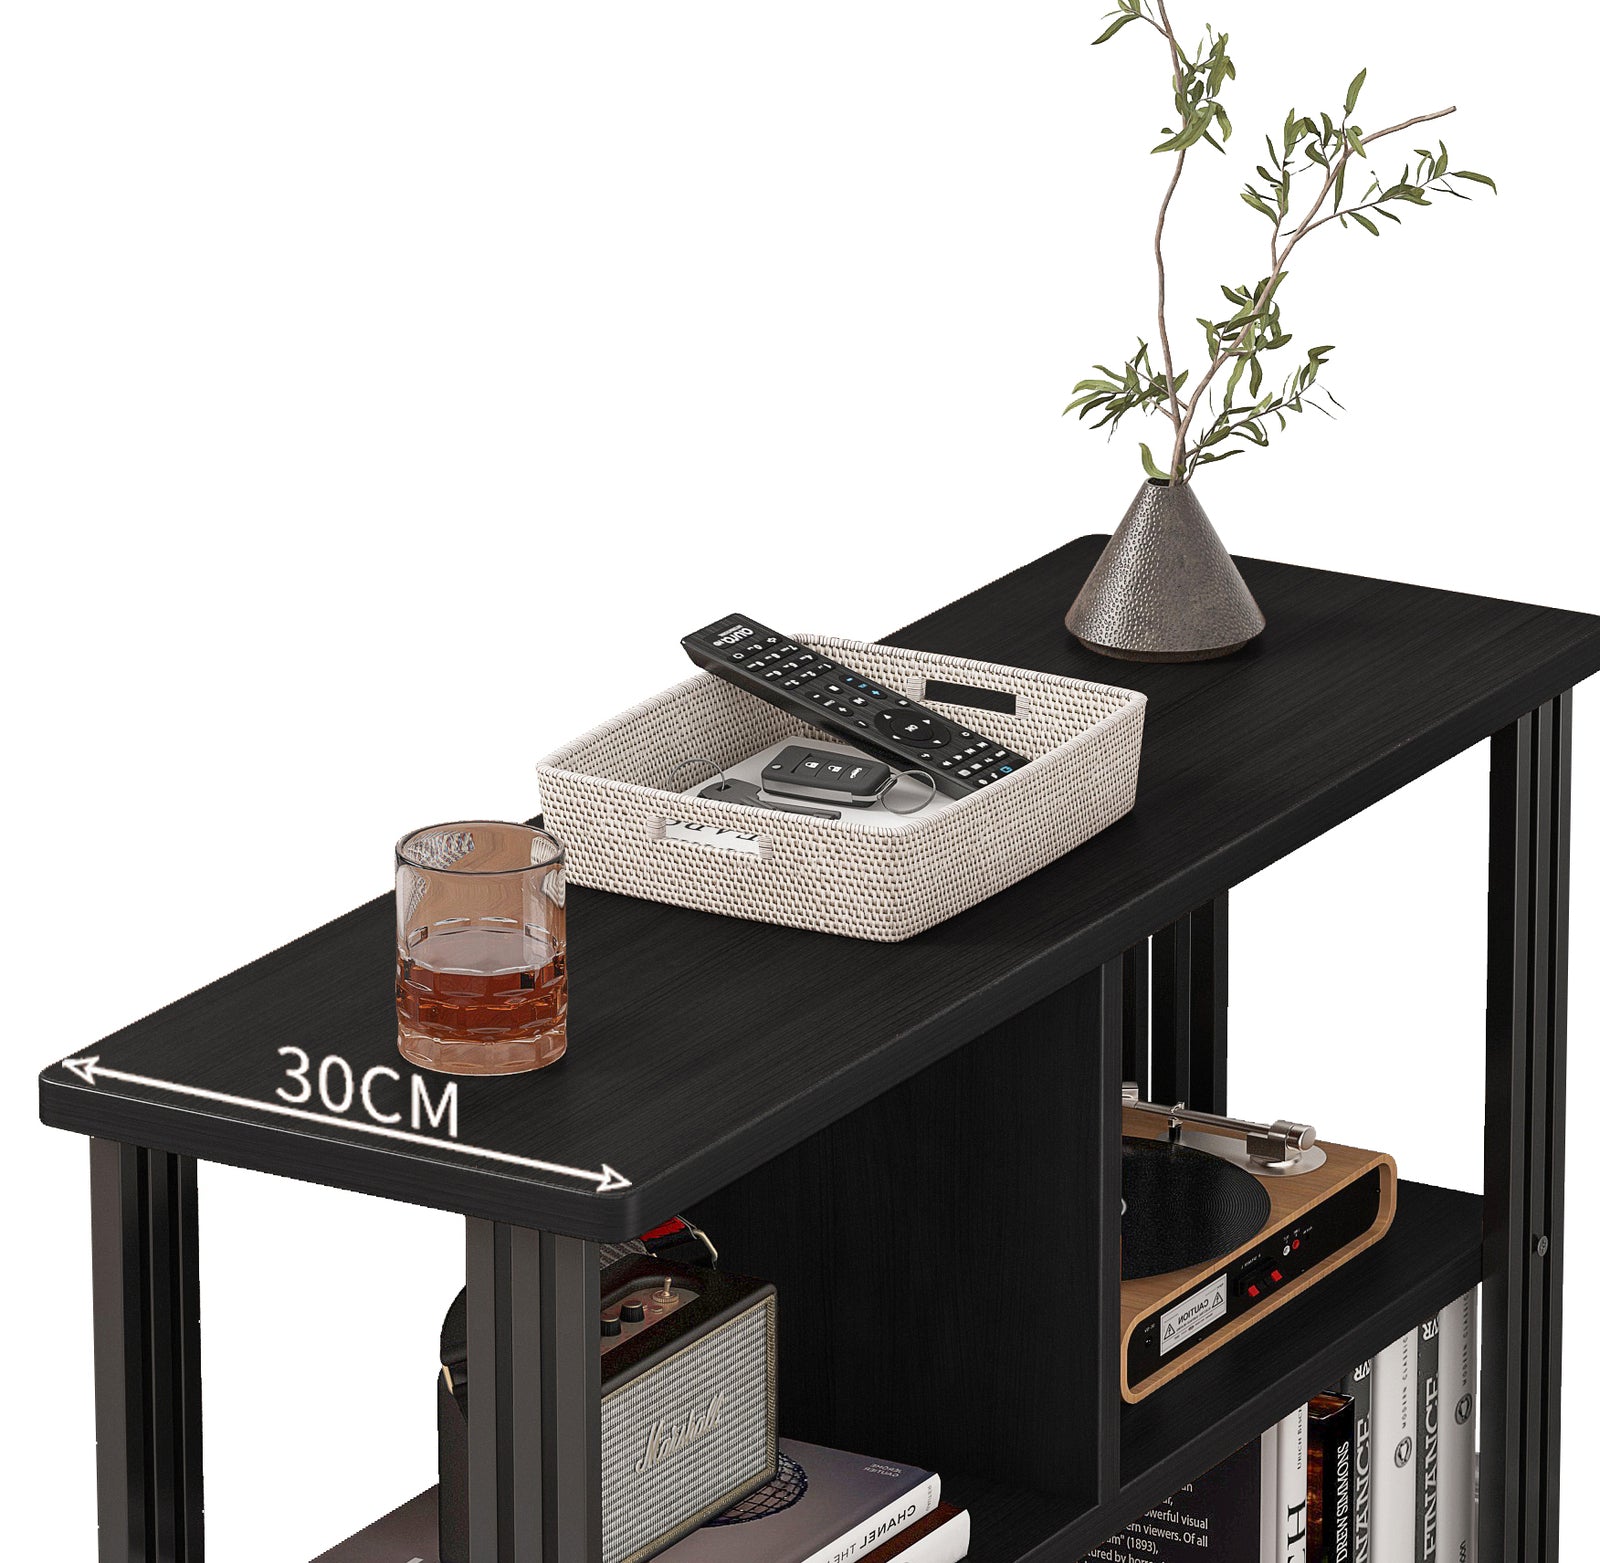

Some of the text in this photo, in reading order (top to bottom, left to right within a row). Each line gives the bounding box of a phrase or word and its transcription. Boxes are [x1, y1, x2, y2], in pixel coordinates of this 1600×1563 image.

[635, 1391, 724, 1474] Marshall
[1336, 1441, 1349, 1517] SIMMONS
[1181, 1514, 1208, 1530] visual
[1126, 1536, 1159, 1555] (1893),
[1143, 1524, 1182, 1542] viewers.
[1183, 1532, 1195, 1545] Of
[1197, 1535, 1208, 1548] all
[1088, 1549, 1113, 1561] ured
